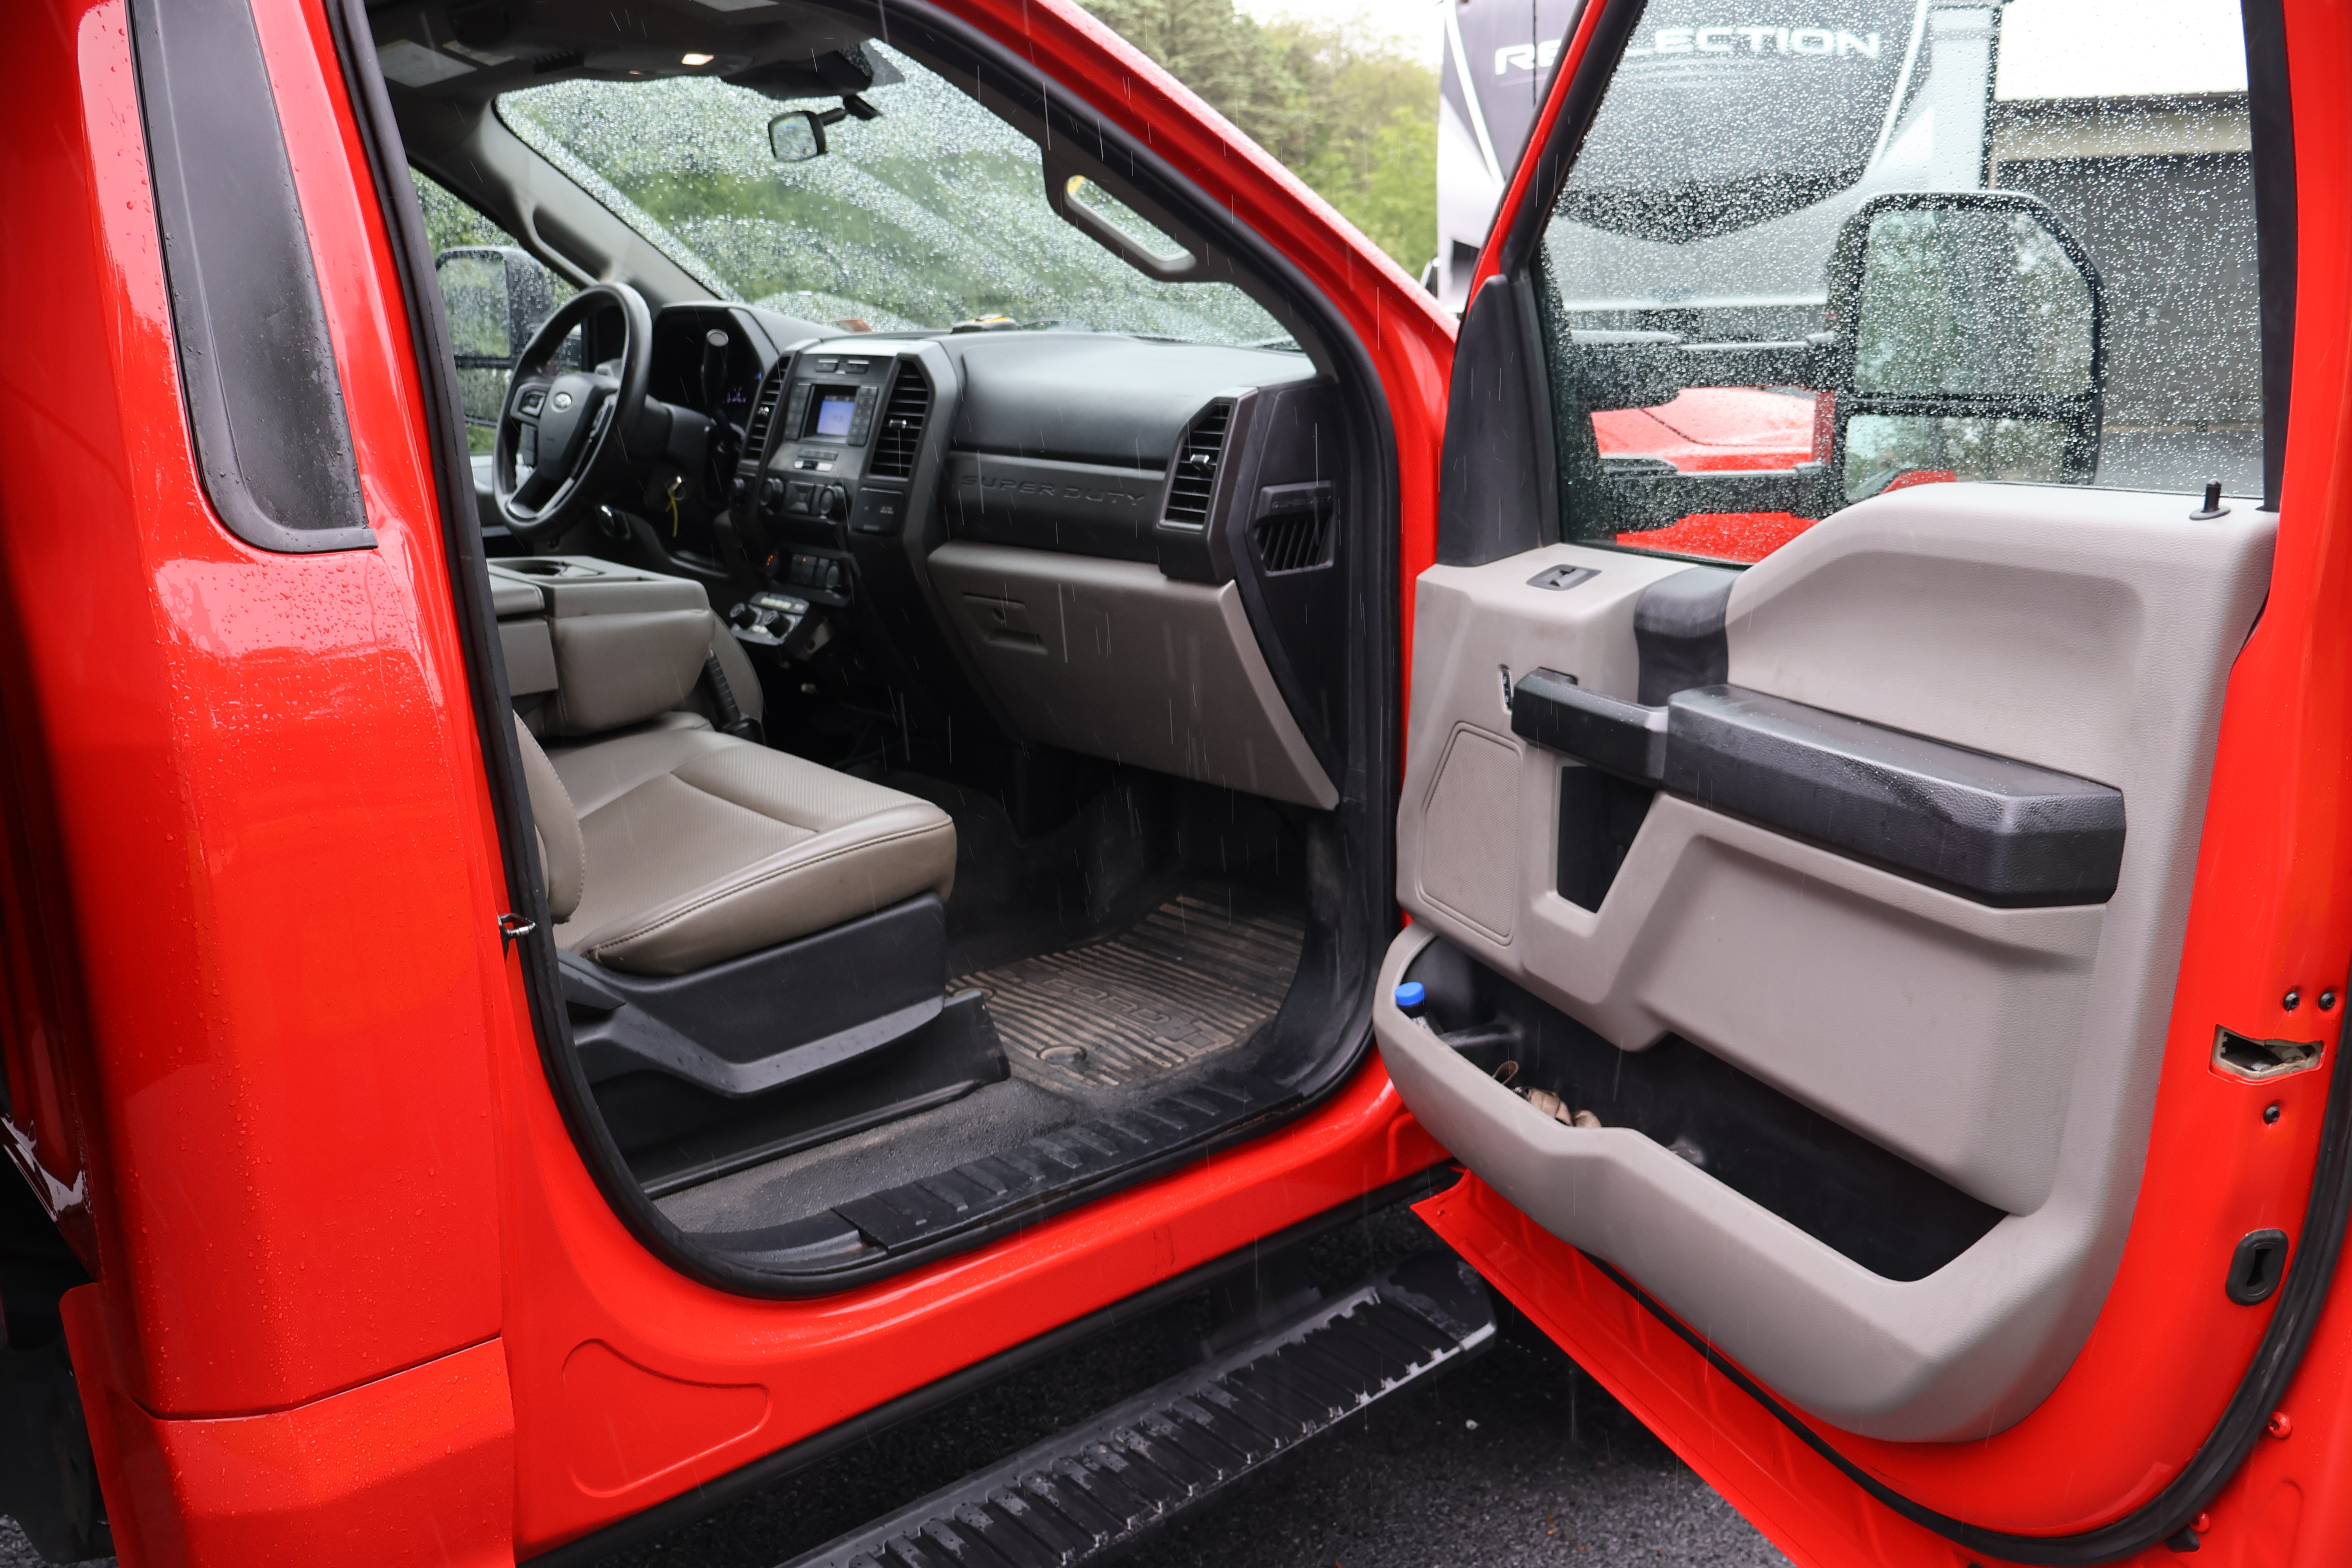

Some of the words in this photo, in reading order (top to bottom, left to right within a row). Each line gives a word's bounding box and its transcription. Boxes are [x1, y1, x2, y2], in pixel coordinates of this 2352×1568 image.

[1494, 26, 1880, 75] REECTION
[962, 475, 1055, 496] SUPER
[1063, 487, 1145, 506] DUTY
[1043, 978, 1171, 1024] FORD
